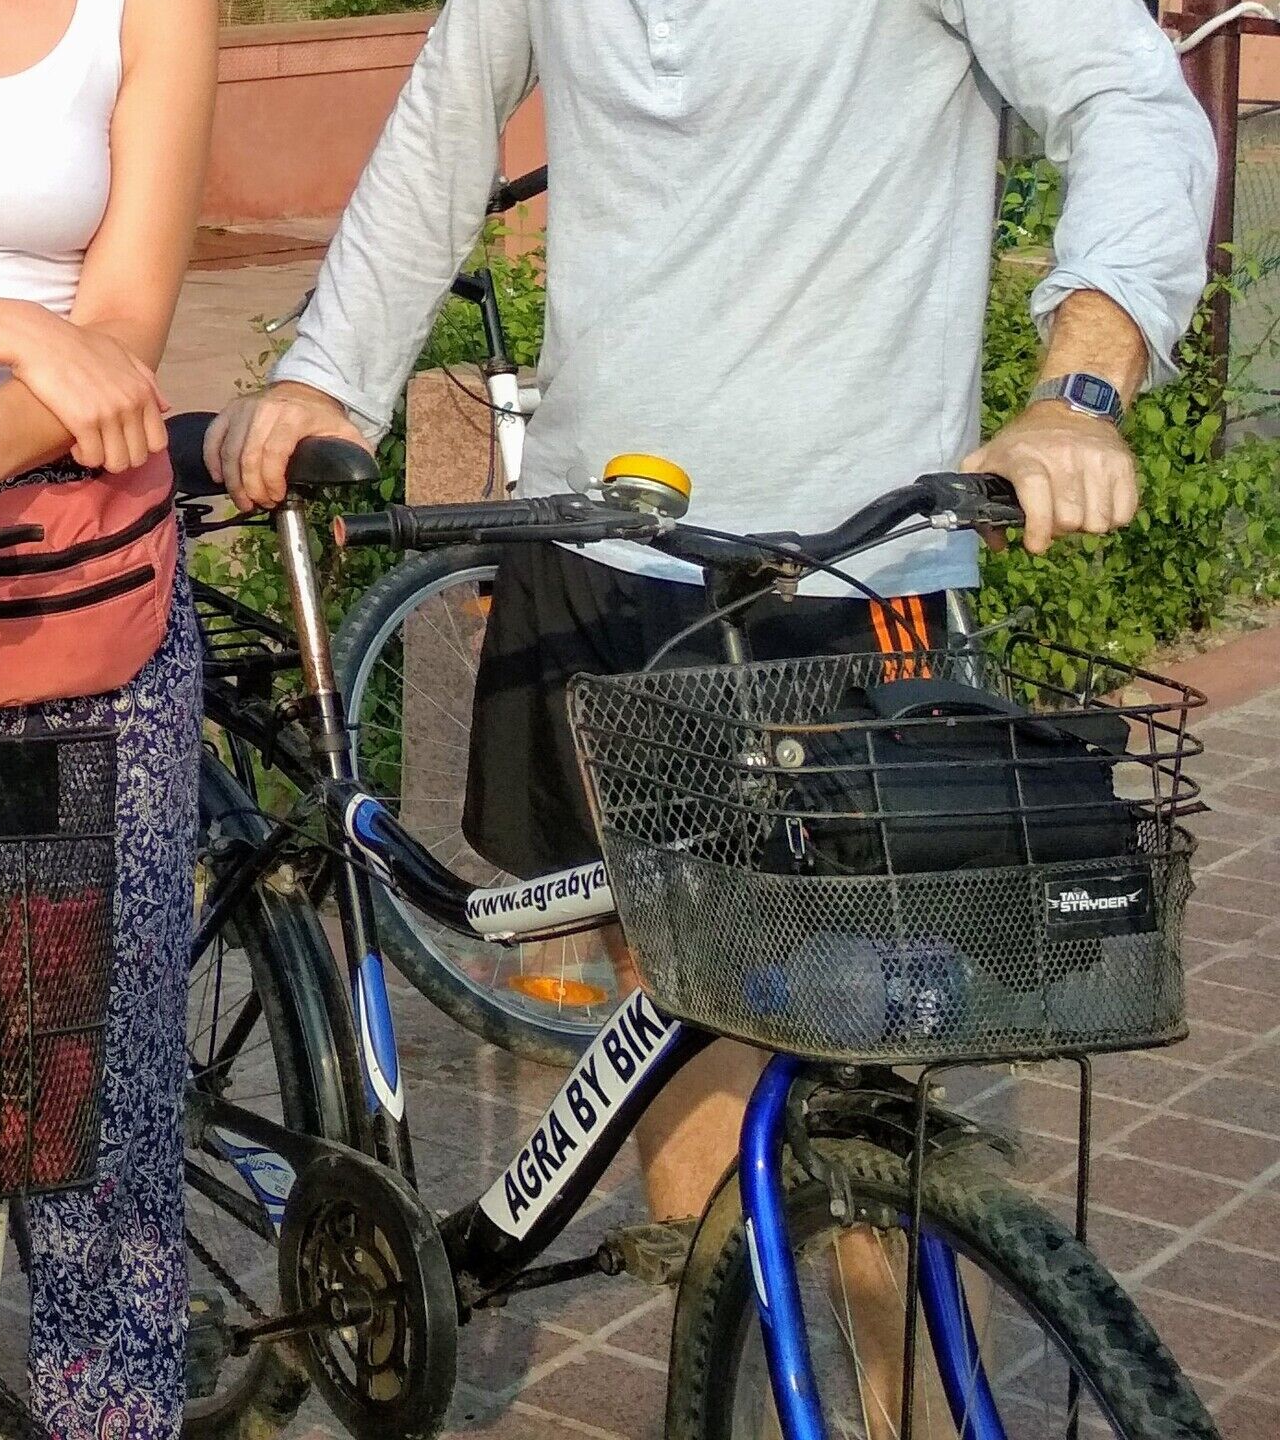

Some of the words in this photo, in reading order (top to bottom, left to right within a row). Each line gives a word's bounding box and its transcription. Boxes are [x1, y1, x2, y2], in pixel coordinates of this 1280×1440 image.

[1060, 891, 1090, 902] TATA
[1060, 896, 1128, 913] STRYDER
[502, 1108, 580, 1225] AGRA
[565, 1056, 612, 1134] BY
